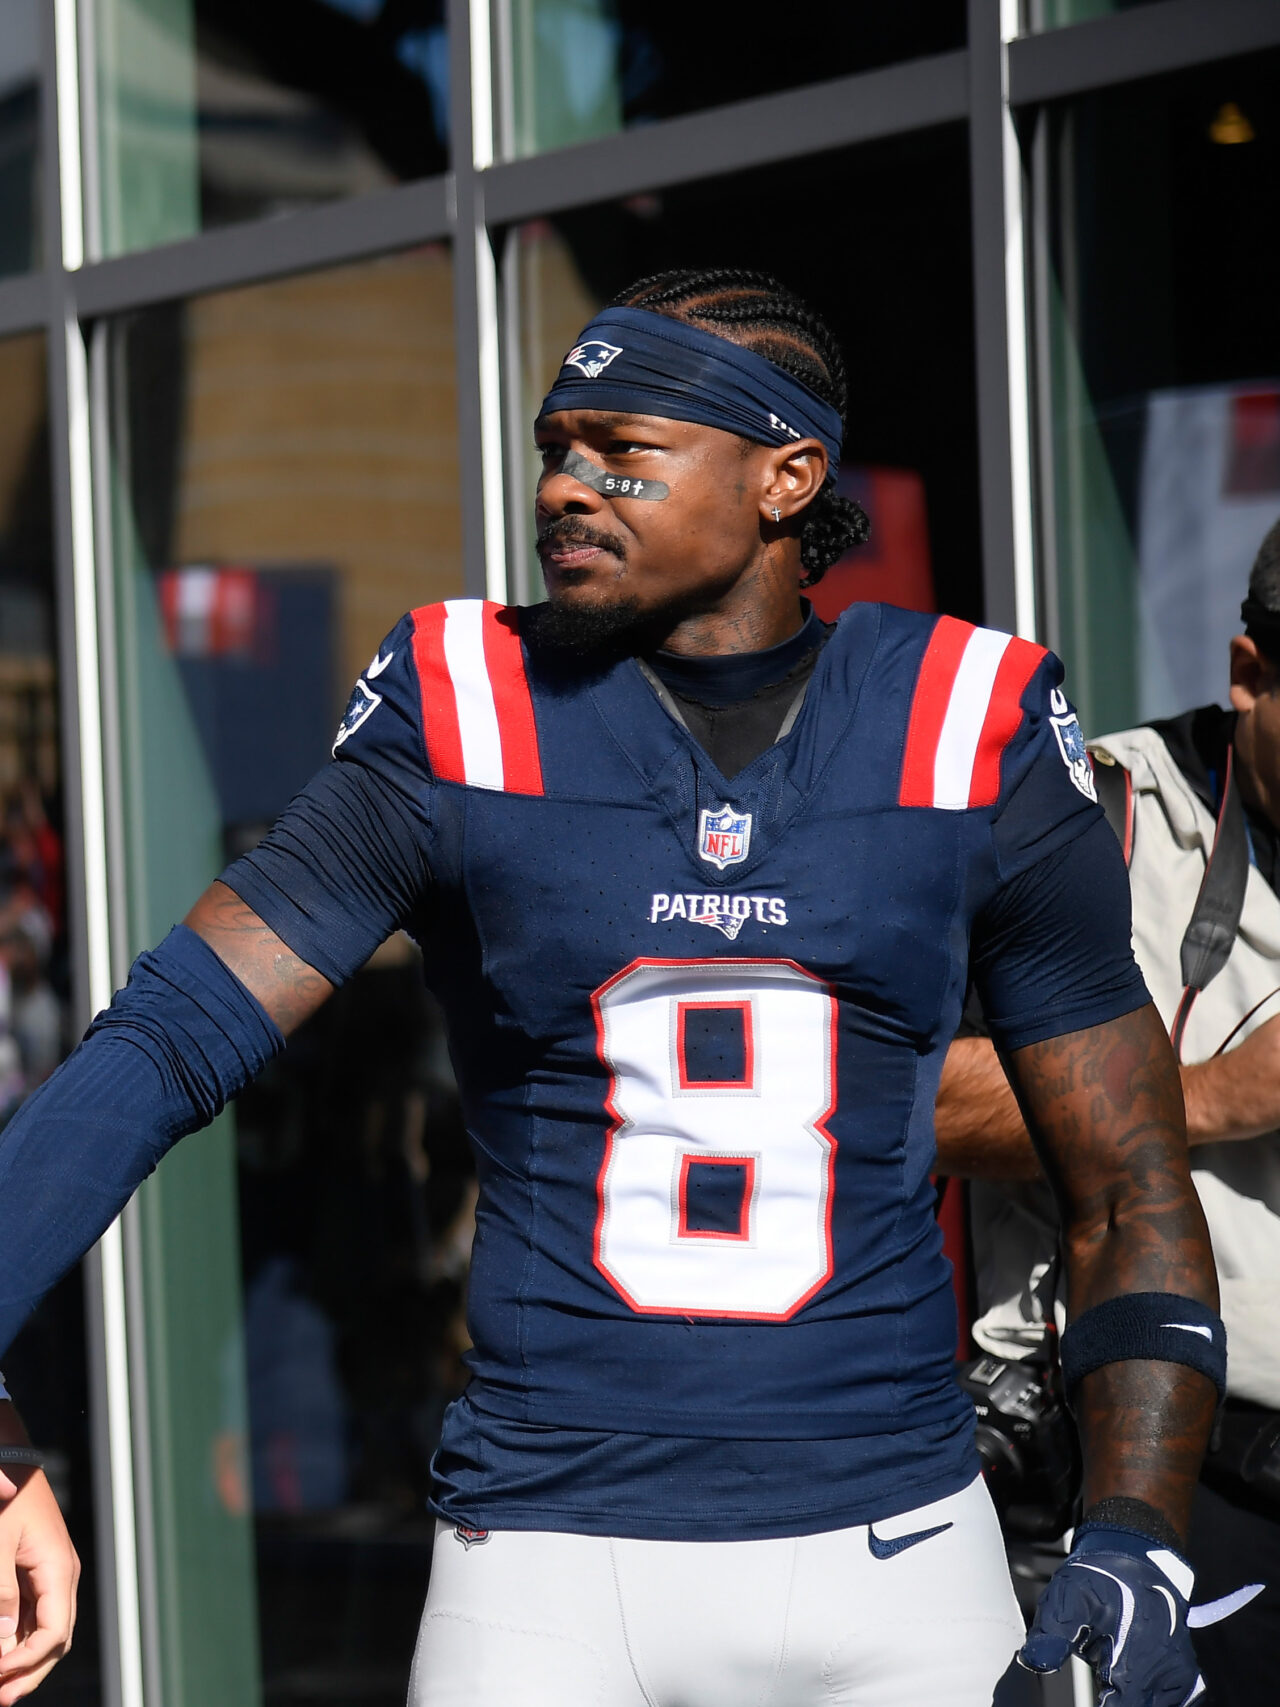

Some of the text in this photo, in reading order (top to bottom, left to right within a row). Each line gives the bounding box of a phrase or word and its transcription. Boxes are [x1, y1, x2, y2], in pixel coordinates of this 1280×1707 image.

[706, 833, 741, 858] NFL
[651, 893, 789, 926] PATRIOTS
[590, 957, 838, 1322] 8
